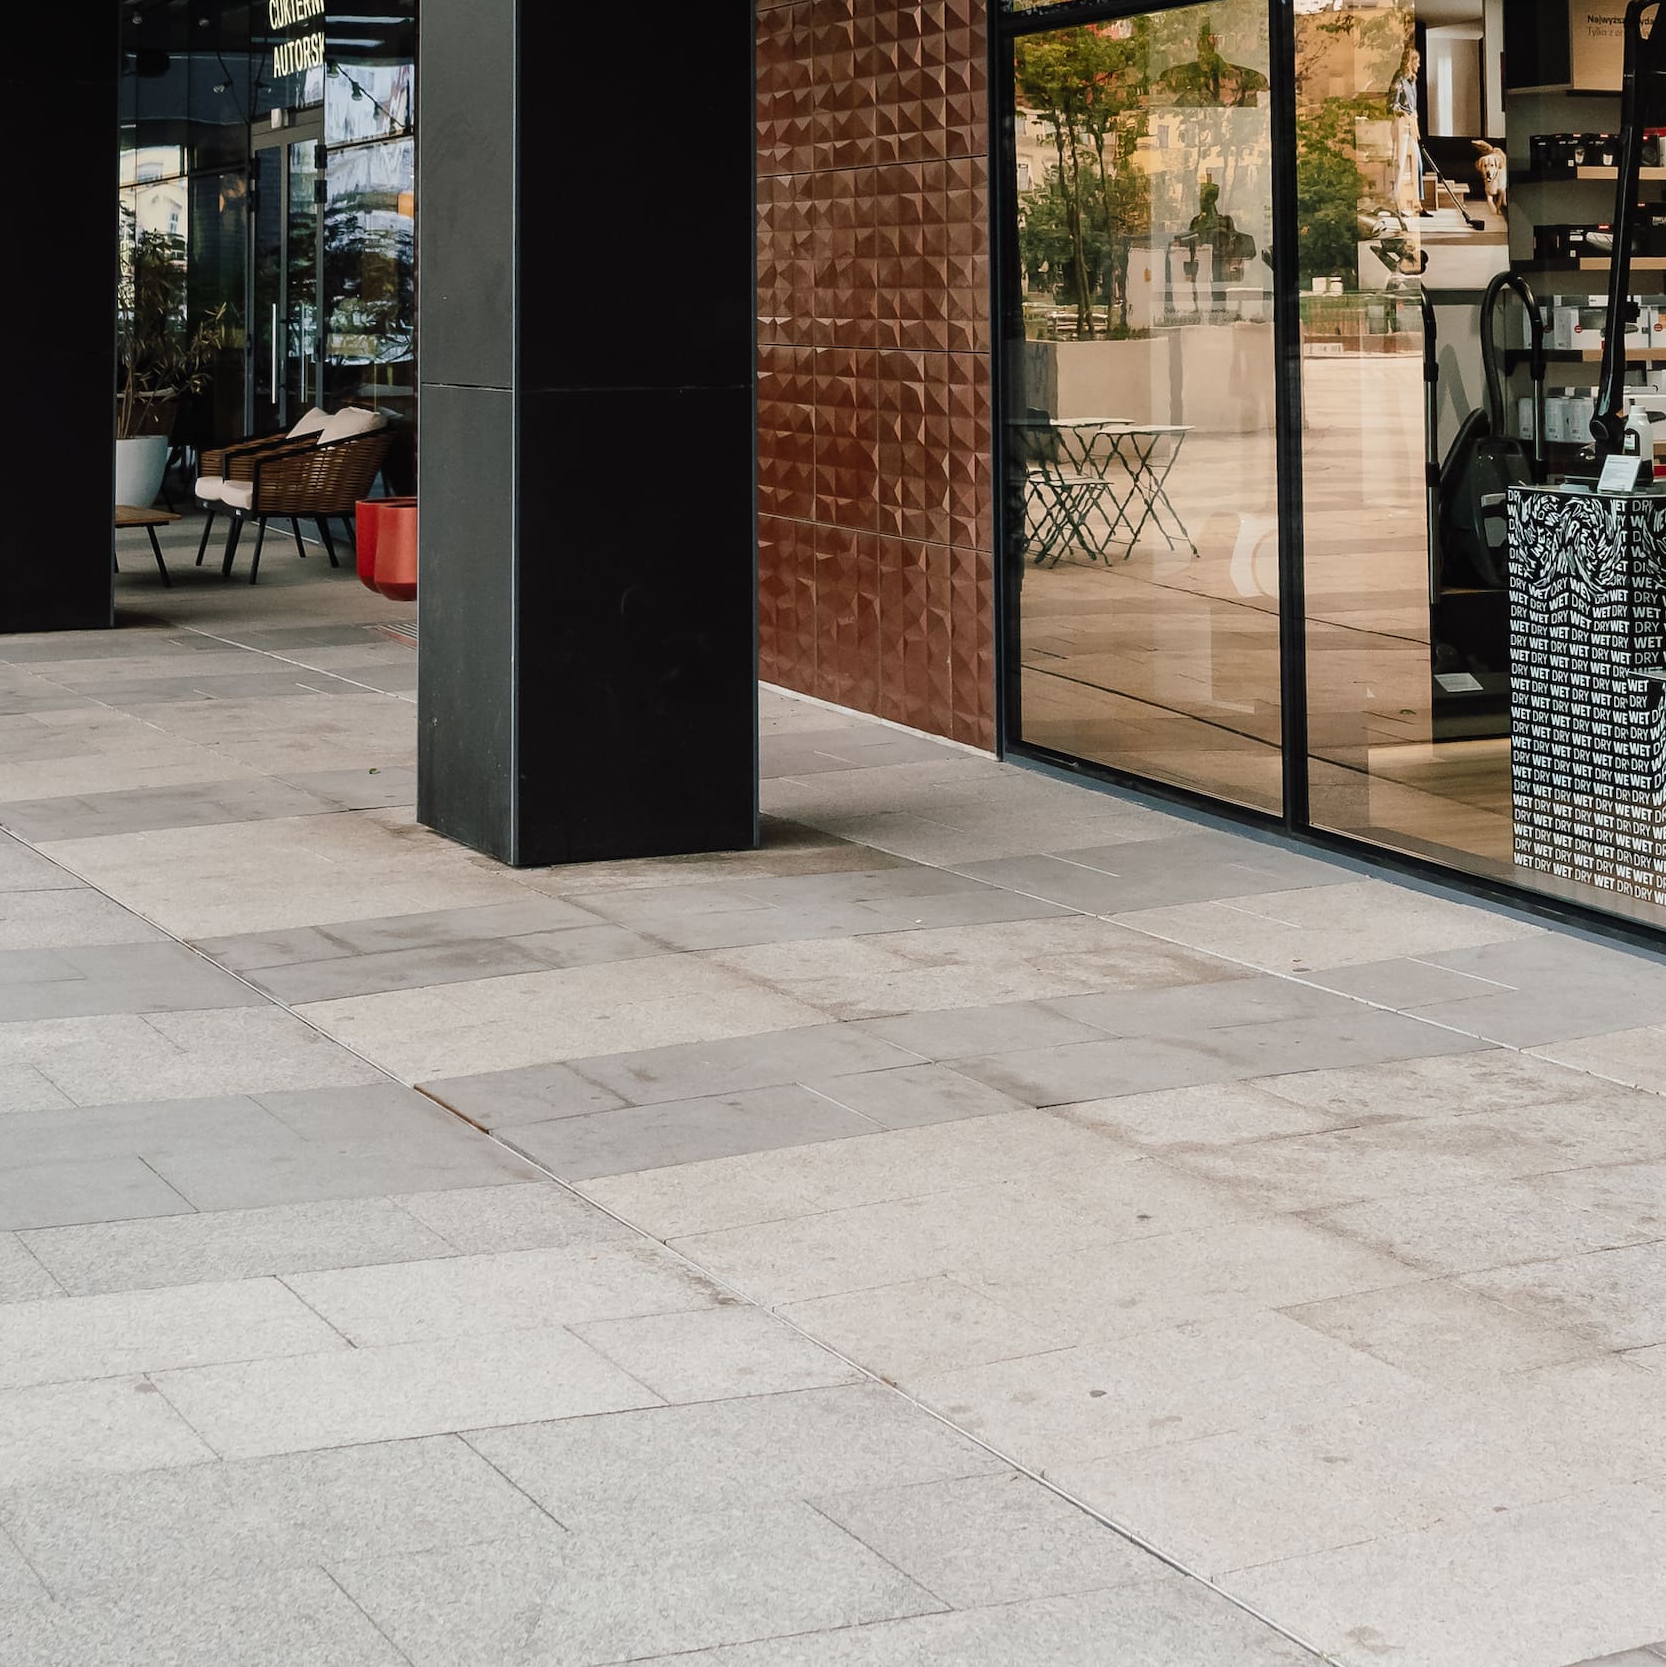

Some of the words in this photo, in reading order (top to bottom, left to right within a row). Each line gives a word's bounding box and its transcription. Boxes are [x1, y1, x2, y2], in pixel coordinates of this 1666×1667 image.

[1634, 591, 1658, 604] DRY
[1633, 607, 1661, 619] WET
[1510, 620, 1530, 633] WET
[1531, 624, 1548, 636] DRY
[1549, 627, 1569, 639] WET
[1572, 628, 1589, 642] DRY
[1591, 634, 1611, 646] WET
[1612, 636, 1629, 649] DRY
[1635, 622, 1659, 633] DRY
[1511, 634, 1527, 647] DRY
[1529, 637, 1549, 650] WET
[1551, 641, 1567, 654] DRY
[1569, 644, 1589, 657] WET
[1592, 647, 1609, 660] DRY
[1611, 650, 1631, 664] WET
[1634, 637, 1663, 648] WET
[1510, 648, 1530, 662] WET
[1531, 652, 1548, 664] DRY
[1550, 655, 1569, 668] WET
[1572, 658, 1588, 671] DRY
[1590, 662, 1611, 674] WET
[1635, 653, 1659, 664] DRY
[1628, 680, 1649, 692] WET
[1630, 695, 1647, 708] DRY
[1629, 713, 1650, 725] WET
[1631, 729, 1648, 741] DRY
[1630, 743, 1650, 757] WET
[1513, 750, 1530, 764] DRY
[1532, 755, 1552, 769] WET
[1554, 759, 1571, 773] DRY
[1572, 763, 1592, 778] WET
[1595, 768, 1612, 782] DRY
[1631, 759, 1649, 772] DRY
[1512, 765, 1532, 780] WET
[1534, 770, 1551, 784] DRY
[1552, 774, 1572, 789] WET
[1574, 779, 1591, 793] DRY
[1593, 783, 1613, 798] WET
[1630, 776, 1652, 789] WET
[1514, 780, 1531, 794] DRY
[1533, 784, 1552, 799] WET
[1554, 789, 1572, 803] DRY
[1573, 793, 1593, 808] WET
[1595, 799, 1613, 813] DRY
[1632, 791, 1650, 805] DRY
[1513, 794, 1533, 809] WET
[1534, 799, 1551, 813] DRY
[1552, 803, 1572, 818] WET
[1574, 809, 1591, 823] DRY
[1593, 813, 1613, 828] WET
[1631, 805, 1652, 821] WET
[1514, 809, 1532, 823] DRY
[1533, 813, 1553, 829] WET
[1555, 819, 1572, 833] DRY
[1573, 823, 1593, 838] WET
[1596, 829, 1613, 843] DRY
[1634, 821, 1651, 835] DRY
[1513, 823, 1533, 838] WET
[1535, 828, 1552, 843] DRY
[1553, 833, 1572, 848] WET
[1574, 838, 1592, 853] DRY
[1594, 843, 1613, 858] WET
[1632, 836, 1653, 853] WET
[1515, 838, 1532, 853] DRY
[1534, 843, 1553, 858] WET
[1555, 849, 1573, 863] DRY
[1574, 853, 1593, 869] WET
[1596, 859, 1614, 874] DRY
[1634, 854, 1651, 869] DRY
[1514, 853, 1534, 868] WET
[1535, 858, 1552, 873] DRY
[1553, 863, 1573, 879] WET
[1575, 869, 1592, 884] DRY
[1594, 874, 1614, 890] WET
[1634, 869, 1654, 884] WET
[1635, 886, 1652, 901] DRY
